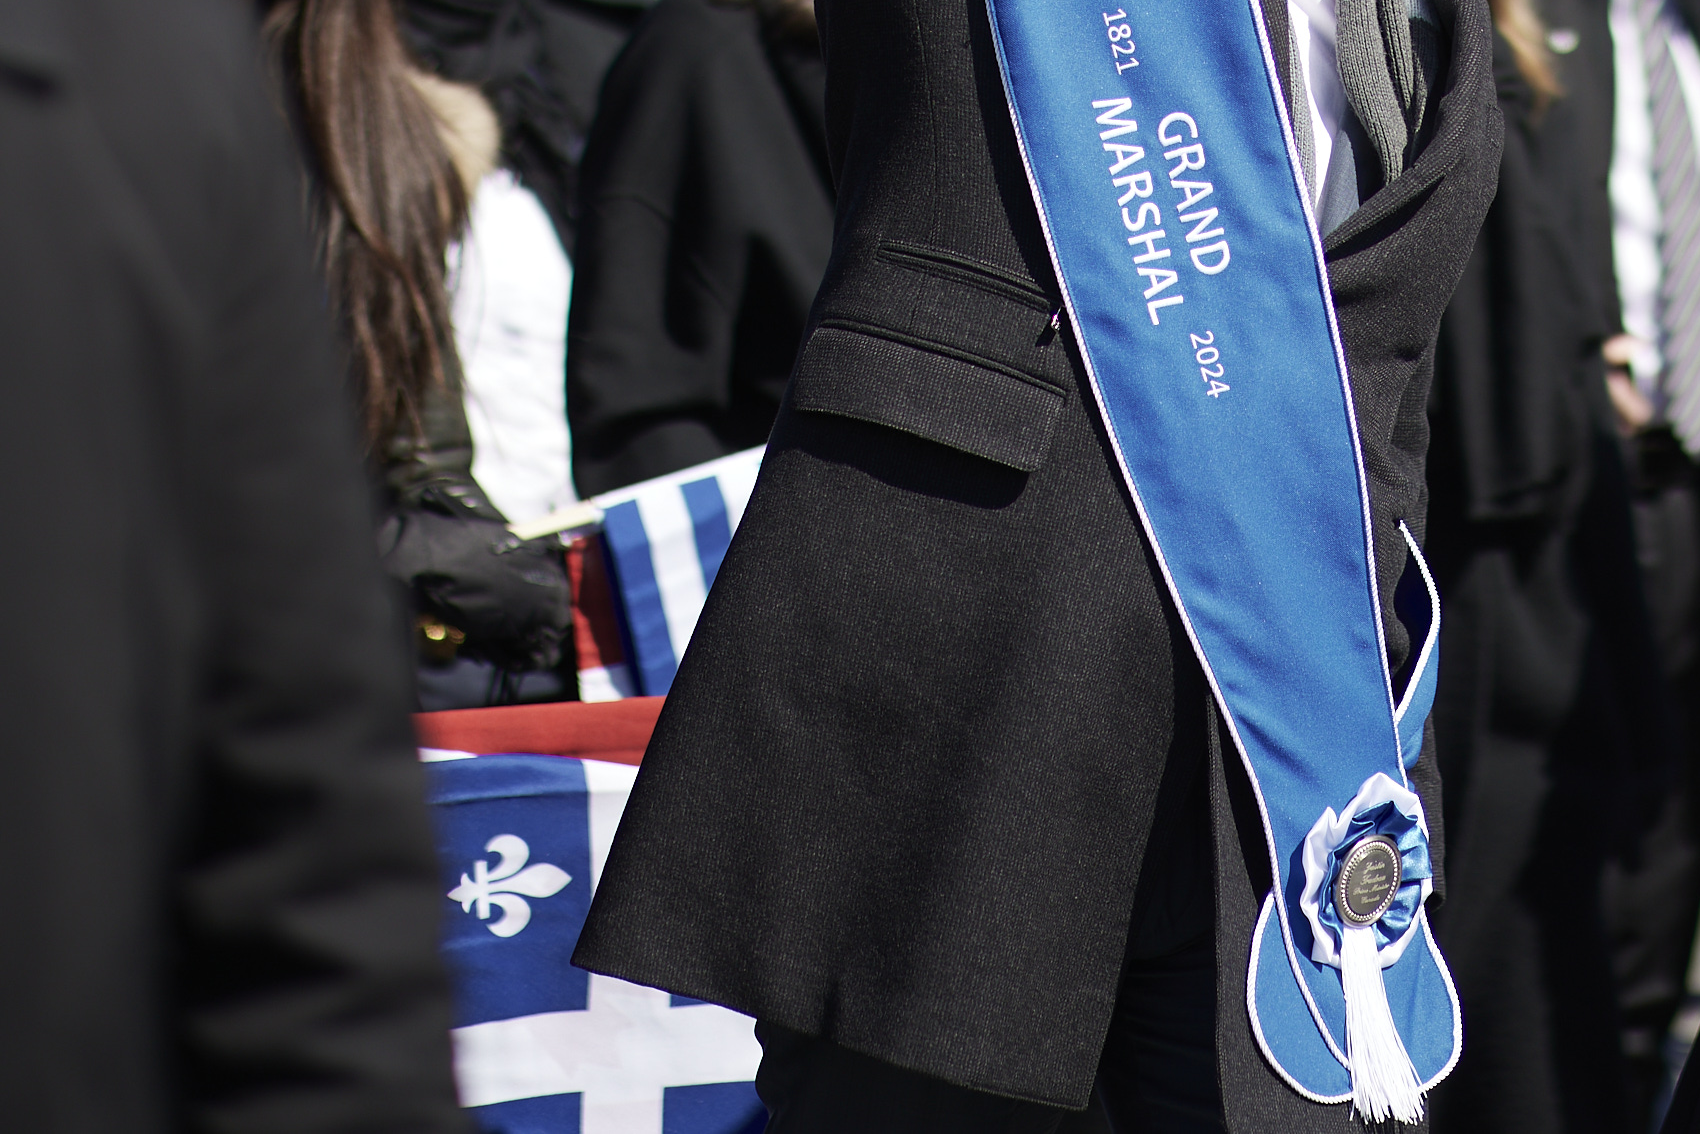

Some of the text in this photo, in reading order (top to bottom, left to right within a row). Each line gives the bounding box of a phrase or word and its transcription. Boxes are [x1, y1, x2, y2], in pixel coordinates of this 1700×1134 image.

[1102, 7, 1140, 76] 1821
[1090, 96, 1185, 326] MARSHAL
[1157, 111, 1231, 276] GRAND
[1189, 329, 1231, 399] 2024
